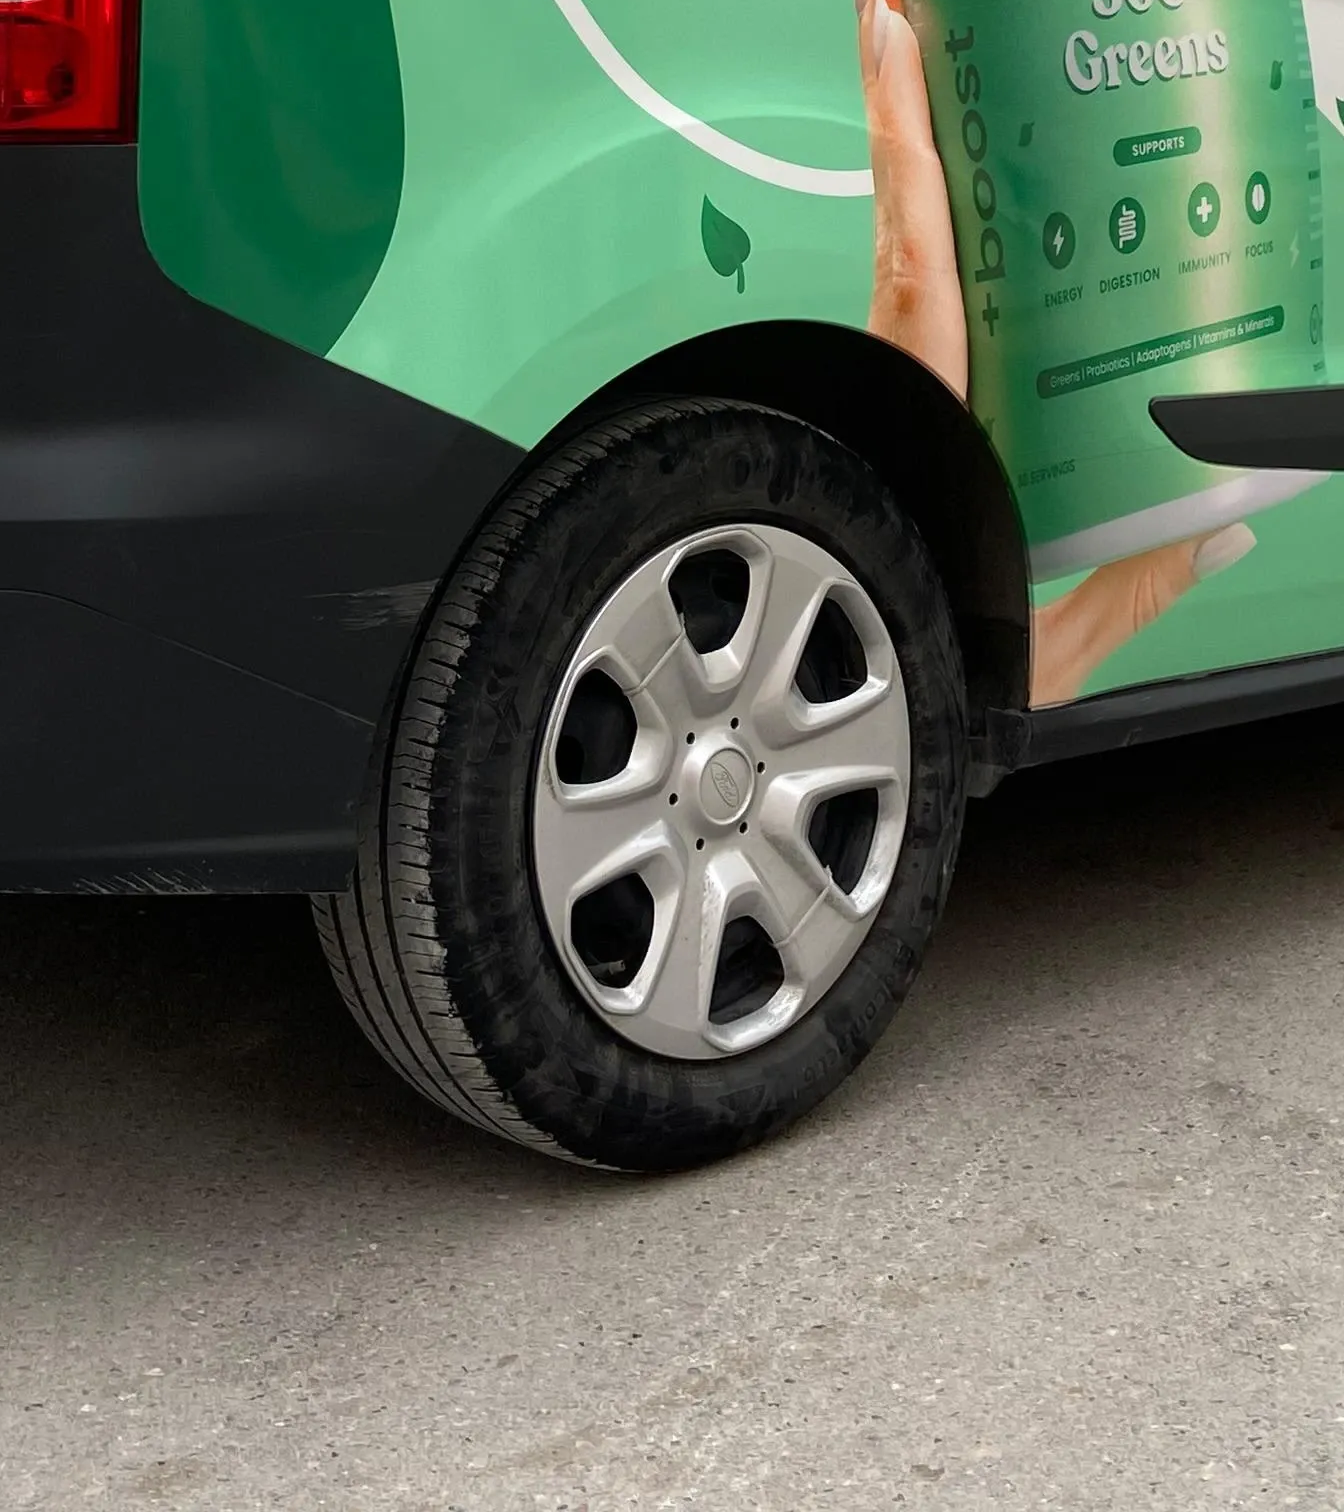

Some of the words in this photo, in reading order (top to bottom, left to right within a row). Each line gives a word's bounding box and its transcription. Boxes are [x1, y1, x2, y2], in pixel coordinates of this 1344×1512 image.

[1063, 28, 1230, 95] Greens
[1131, 135, 1185, 157] SUPPORTS
[1044, 285, 1084, 308] ENERGY
[1099, 267, 1161, 294] DIGESTION
[1178, 251, 1232, 275] IMMUNITY
[1245, 240, 1274, 258] FOCUS
[1049, 370, 1081, 388] Greens
[1086, 354, 1130, 377] Probiotics
[1136, 337, 1192, 364] Adaptogens
[1198, 324, 1237, 346] Vitamins
